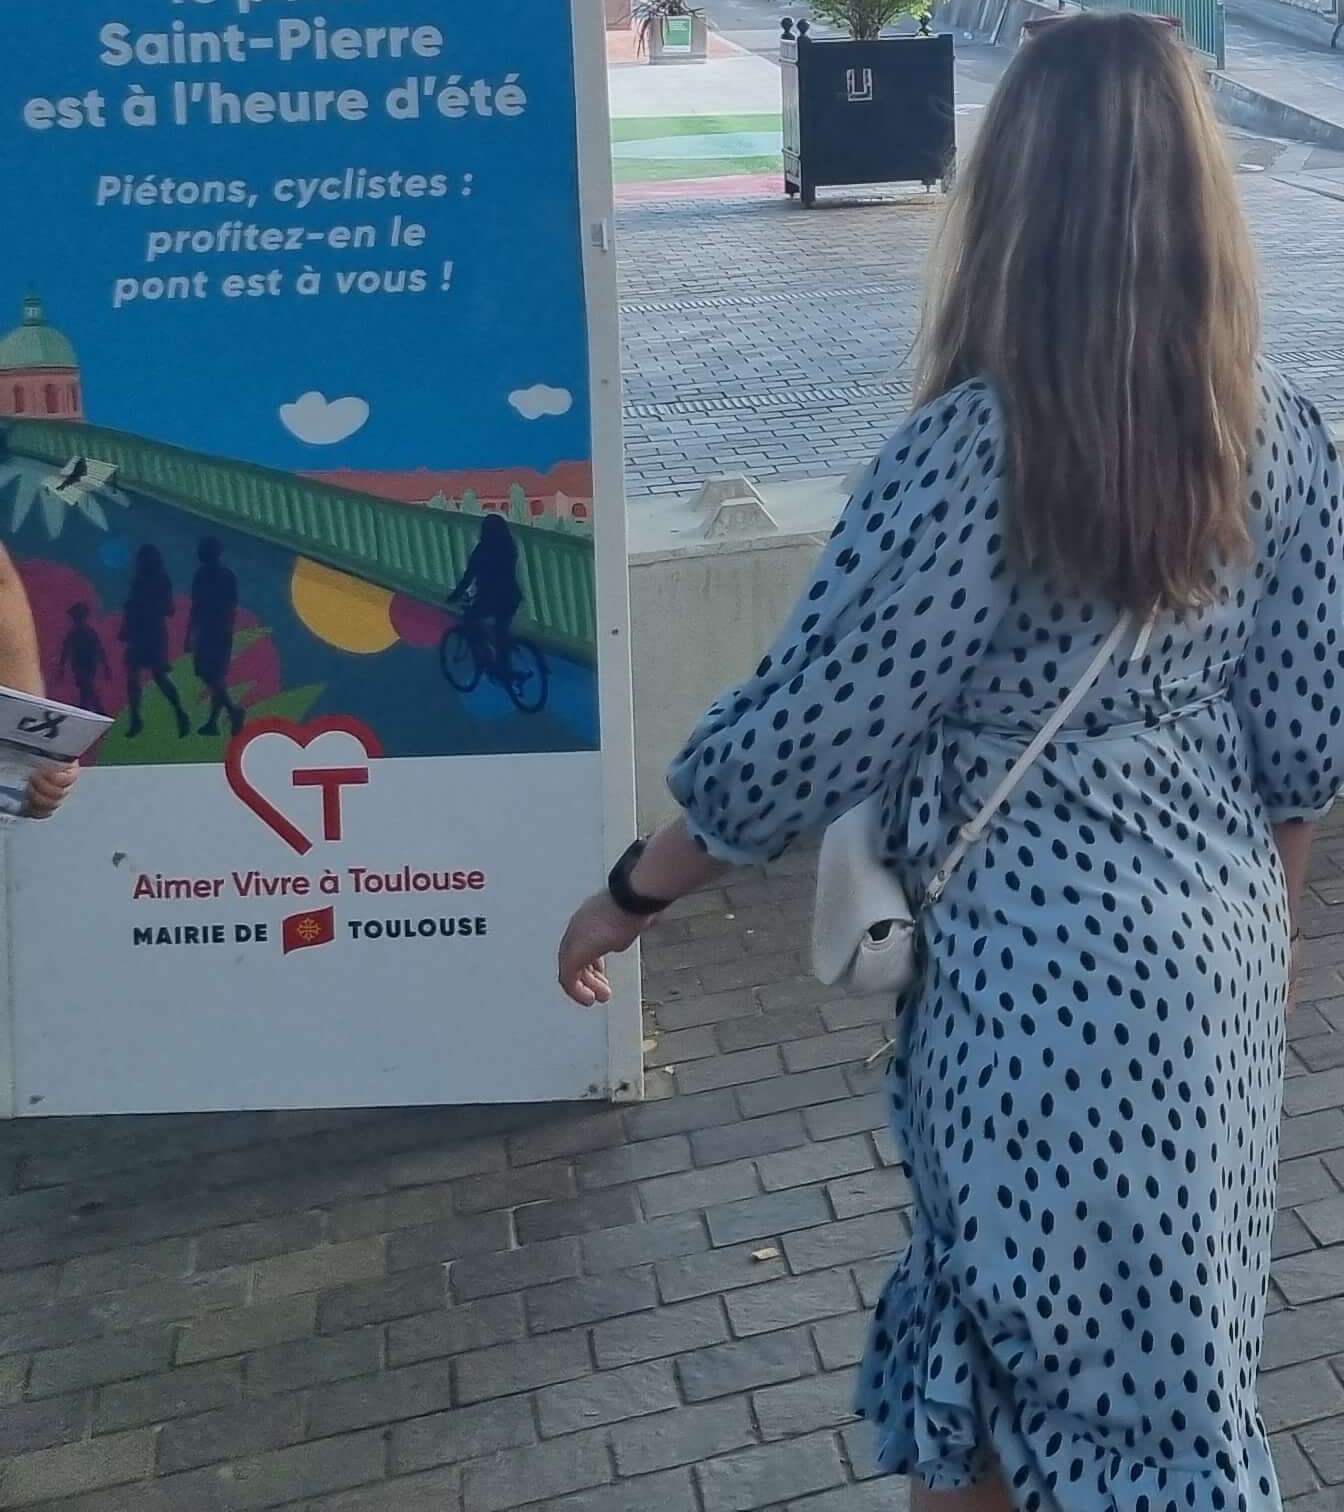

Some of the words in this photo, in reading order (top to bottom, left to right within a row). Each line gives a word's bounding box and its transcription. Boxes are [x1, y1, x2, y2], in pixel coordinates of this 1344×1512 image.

[100, 18, 442, 65] Saint-Pierre
[24, 90, 105, 129] est
[123, 85, 156, 126] à
[174, 82, 368, 124] l'heure
[386, 73, 526, 119] d'été
[97, 175, 258, 207] Piétons,
[274, 168, 447, 208] cyclistes
[147, 221, 376, 262] profitez-en
[391, 216, 425, 246] le
[113, 272, 208, 308] pont
[222, 270, 282, 297] est
[296, 265, 320, 295] à
[336, 270, 426, 293] vous
[133, 874, 224, 899] Aimer
[232, 872, 309, 896] Vivre
[320, 870, 339, 894] à
[348, 866, 484, 892] Toulouse
[134, 926, 224, 945] MAIRIE
[235, 924, 267, 942] DE
[348, 917, 486, 938] TOULOUSE
